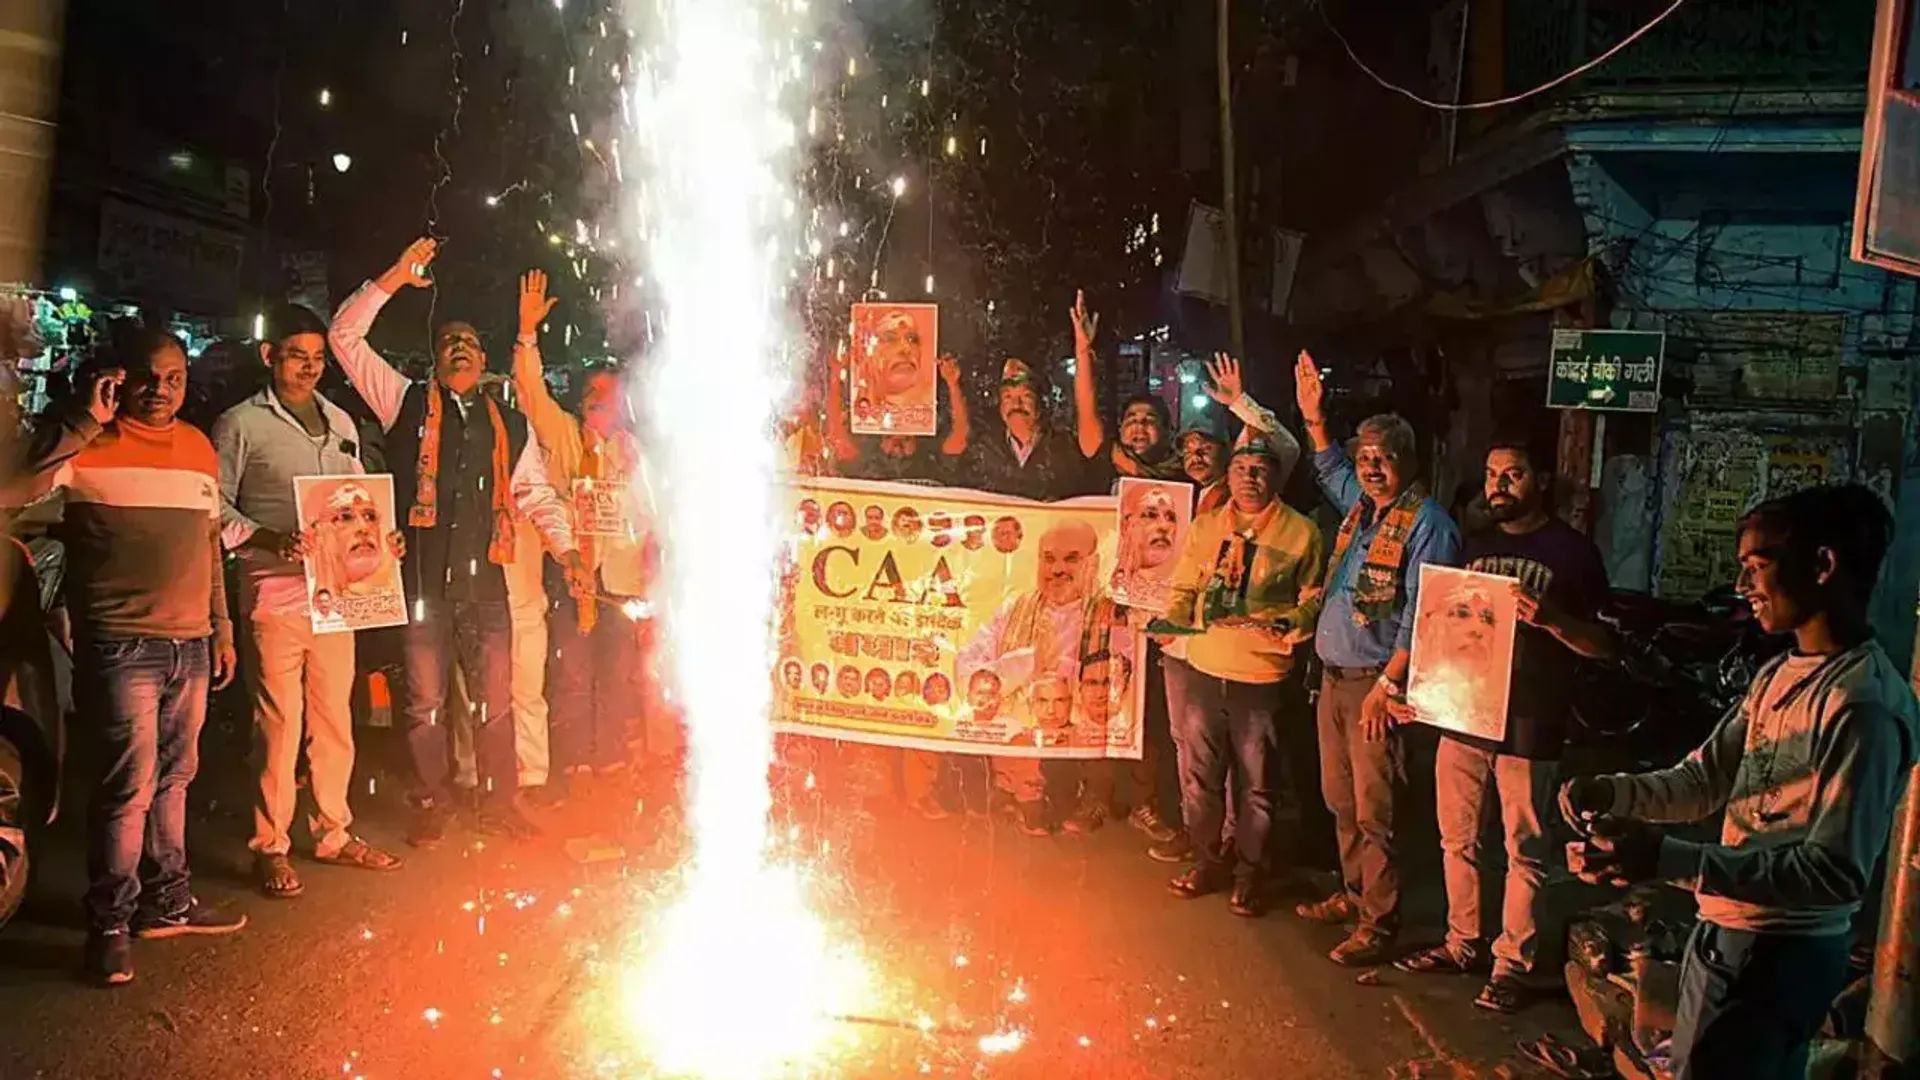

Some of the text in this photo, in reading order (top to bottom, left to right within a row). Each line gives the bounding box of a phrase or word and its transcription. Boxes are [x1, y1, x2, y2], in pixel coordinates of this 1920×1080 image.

[1592, 354, 1621, 382] चौकी
[1624, 355, 1656, 383] गली
[811, 545, 968, 608] CAA
